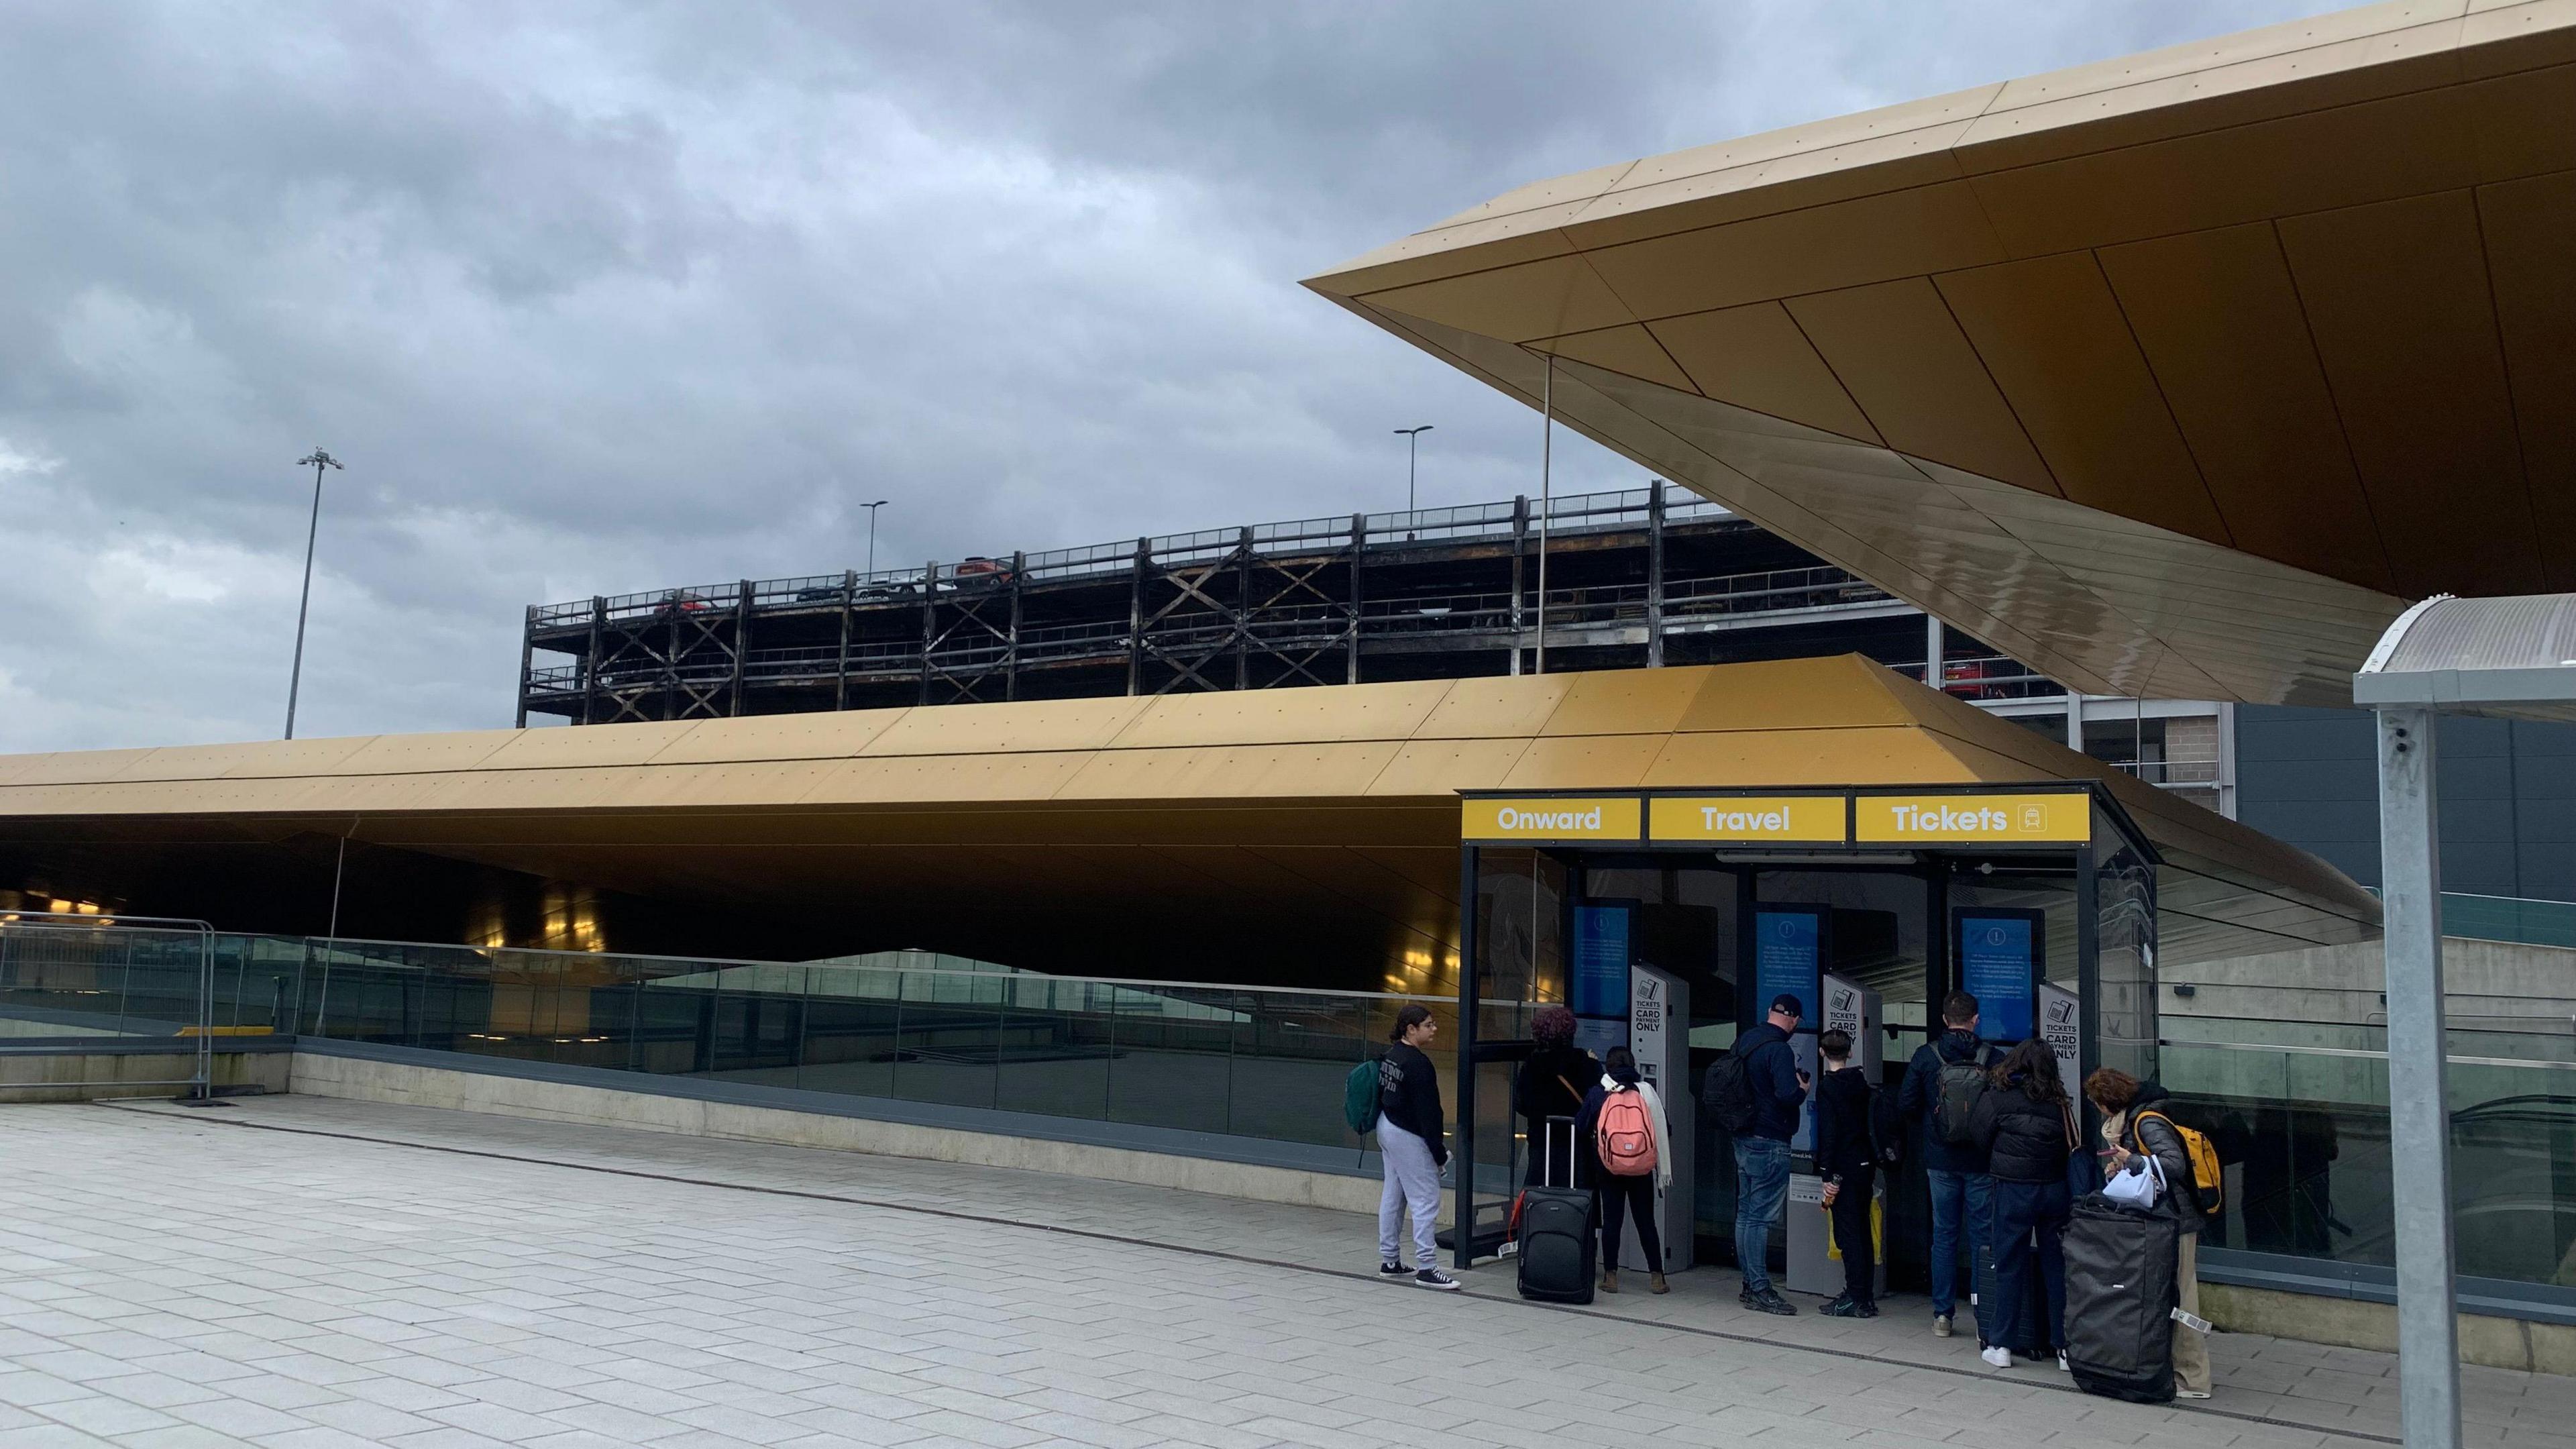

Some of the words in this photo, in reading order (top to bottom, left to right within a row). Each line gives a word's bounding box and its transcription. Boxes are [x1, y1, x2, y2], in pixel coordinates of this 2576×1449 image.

[1498, 806, 1600, 830] Onward
[1701, 806, 1789, 830] Travel
[1891, 804, 2007, 831] Tickets
[1636, 1010, 1660, 1018] CARD
[1830, 1012, 1857, 1020] TICKETS
[1636, 1023, 1660, 1032] ONLY
[1830, 1022, 1857, 1030] CARD
[2046, 1024, 2077, 1032] TICKETS
[2046, 1035, 2076, 1044] CARD
[2056, 1050, 2077, 1059] NLY
